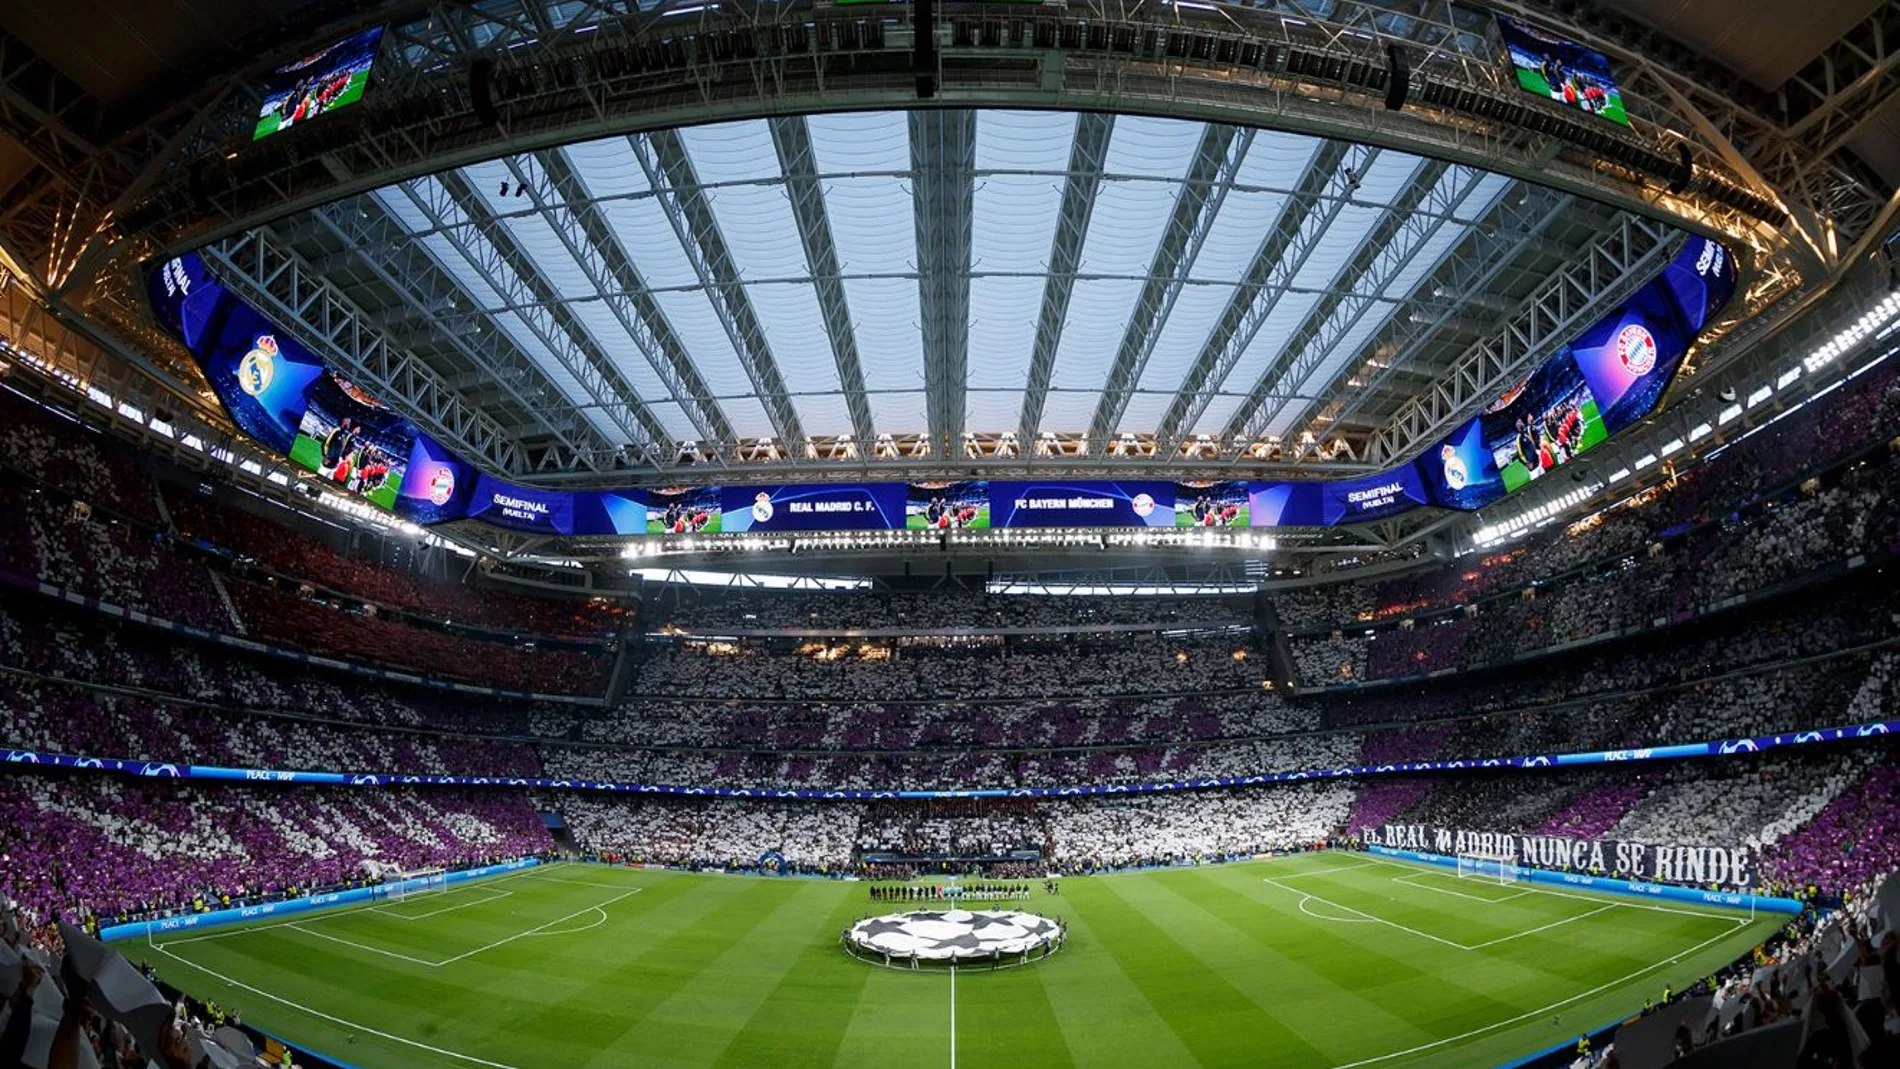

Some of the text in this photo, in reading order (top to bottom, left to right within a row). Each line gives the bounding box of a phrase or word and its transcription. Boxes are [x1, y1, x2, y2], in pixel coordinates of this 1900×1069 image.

[1348, 482, 1403, 503] SEMIFINAL
[493, 493, 549, 513] SEMIFINAL
[790, 502, 813, 512] REAL
[815, 501, 852, 512] MADRID
[1014, 496, 1115, 509] FC BAYERN MÜNCHEN
[502, 507, 535, 521] (VUELTA)
[246, 770, 271, 780] PEACE
[1363, 824, 1750, 886] EL REAL MADRID NUNCA SE RINDE
